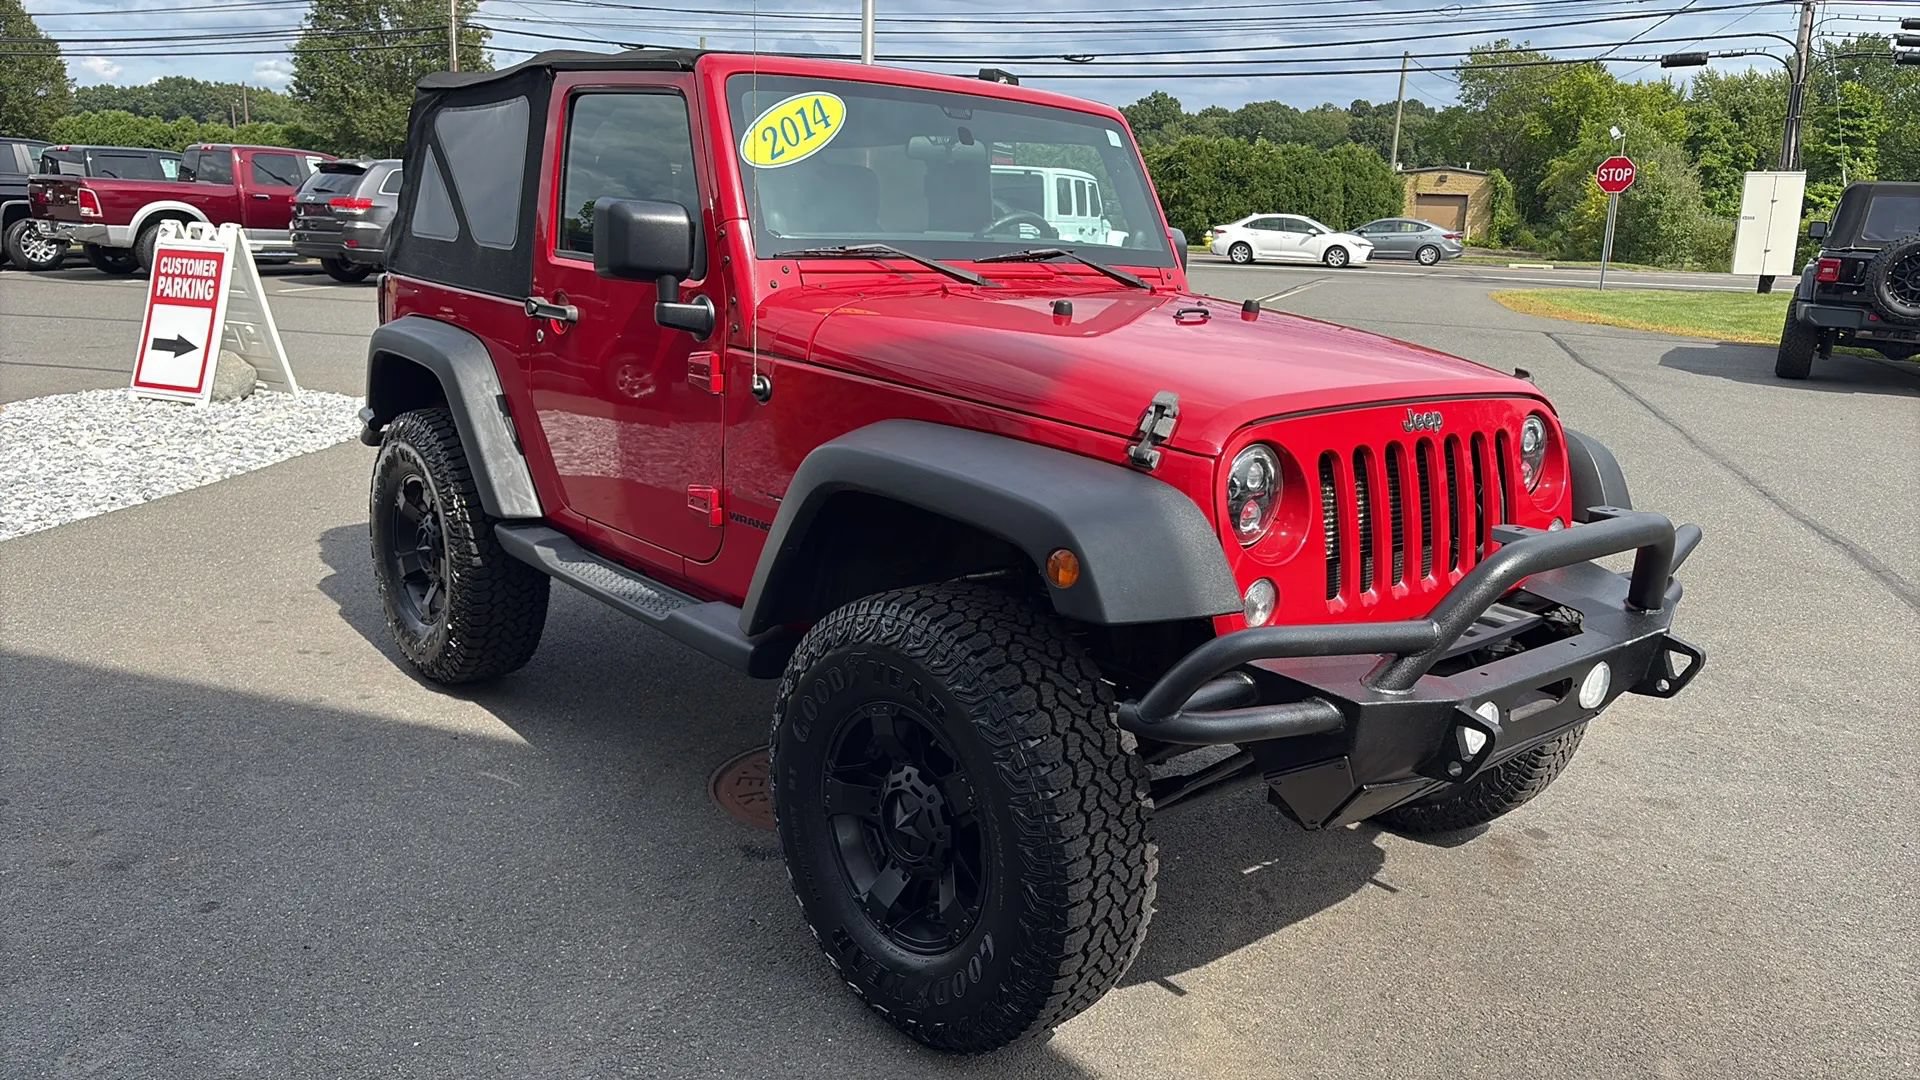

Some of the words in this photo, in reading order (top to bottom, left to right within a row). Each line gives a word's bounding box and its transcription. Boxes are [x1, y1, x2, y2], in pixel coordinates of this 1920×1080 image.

[762, 98, 831, 160] 2014
[1599, 168, 1632, 181] STOP
[160, 256, 217, 277] CUSTOMER
[156, 275, 215, 301] PARKING
[1402, 408, 1443, 433] Jeep
